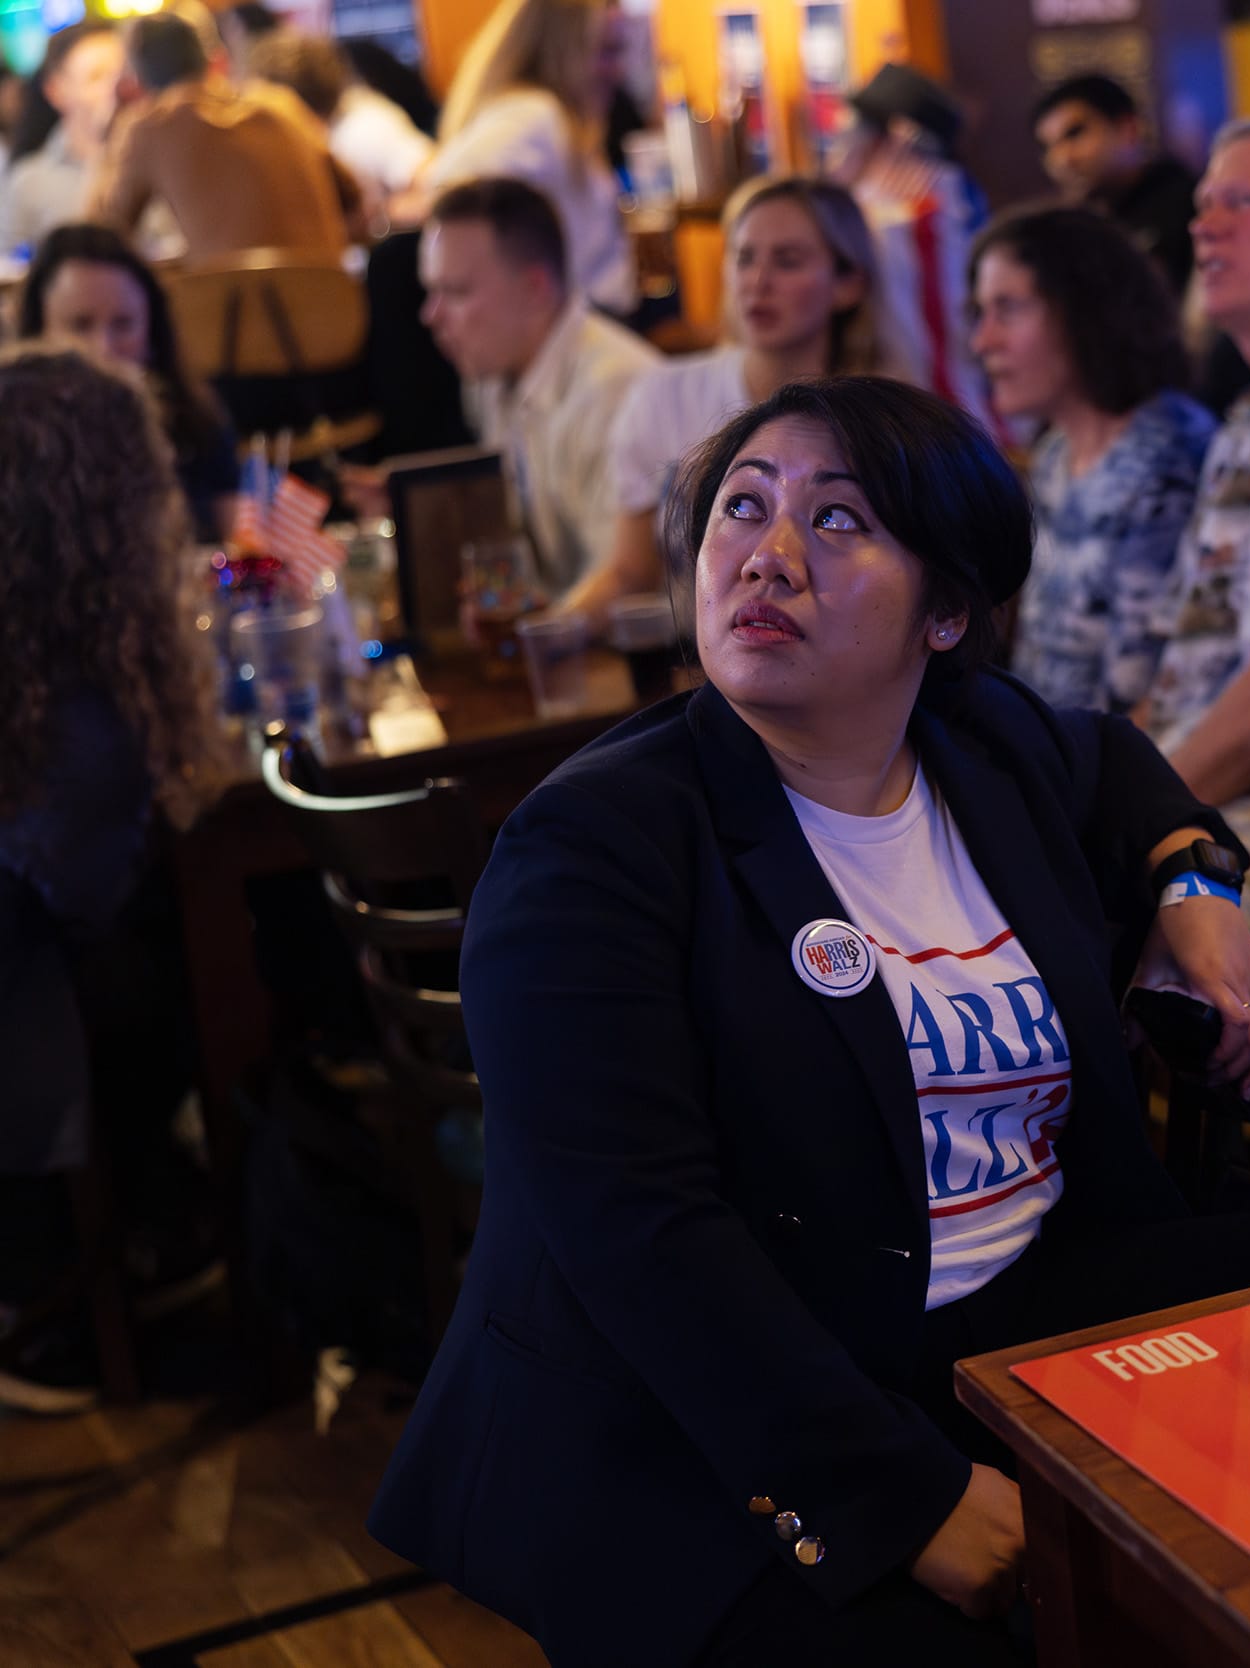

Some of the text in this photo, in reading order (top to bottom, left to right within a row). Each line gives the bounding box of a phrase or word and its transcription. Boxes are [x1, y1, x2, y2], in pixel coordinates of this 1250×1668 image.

[805, 939, 860, 965] HARRIS
[816, 956, 861, 975] WALZ
[925, 1102, 1029, 1200] LZ
[1091, 1331, 1219, 1382] FOOD
